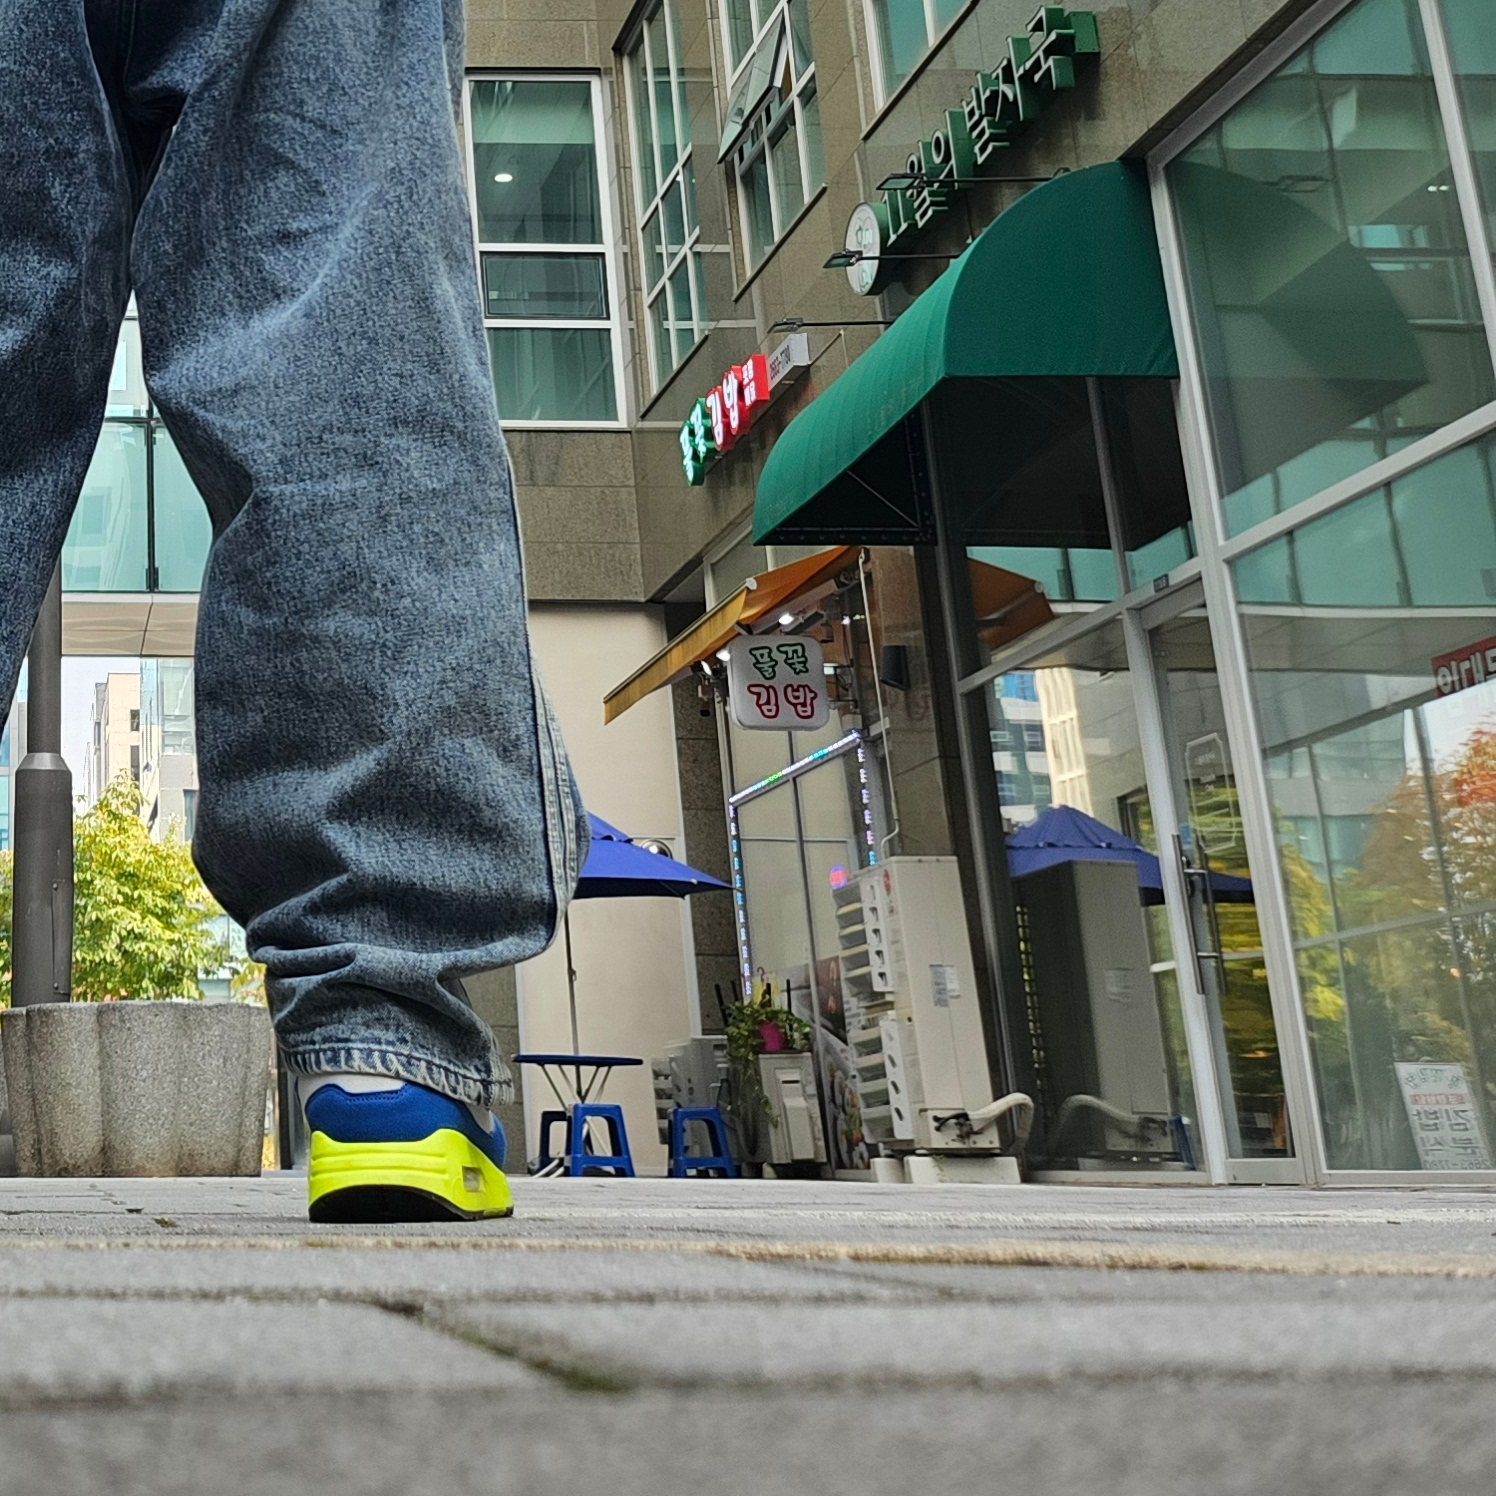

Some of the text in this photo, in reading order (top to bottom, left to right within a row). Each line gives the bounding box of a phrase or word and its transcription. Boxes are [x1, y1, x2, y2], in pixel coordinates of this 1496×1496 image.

[962, 6, 1057, 165] 발자국
[749, 643, 809, 680] 풀꽃
[747, 683, 818, 719] 김밥
